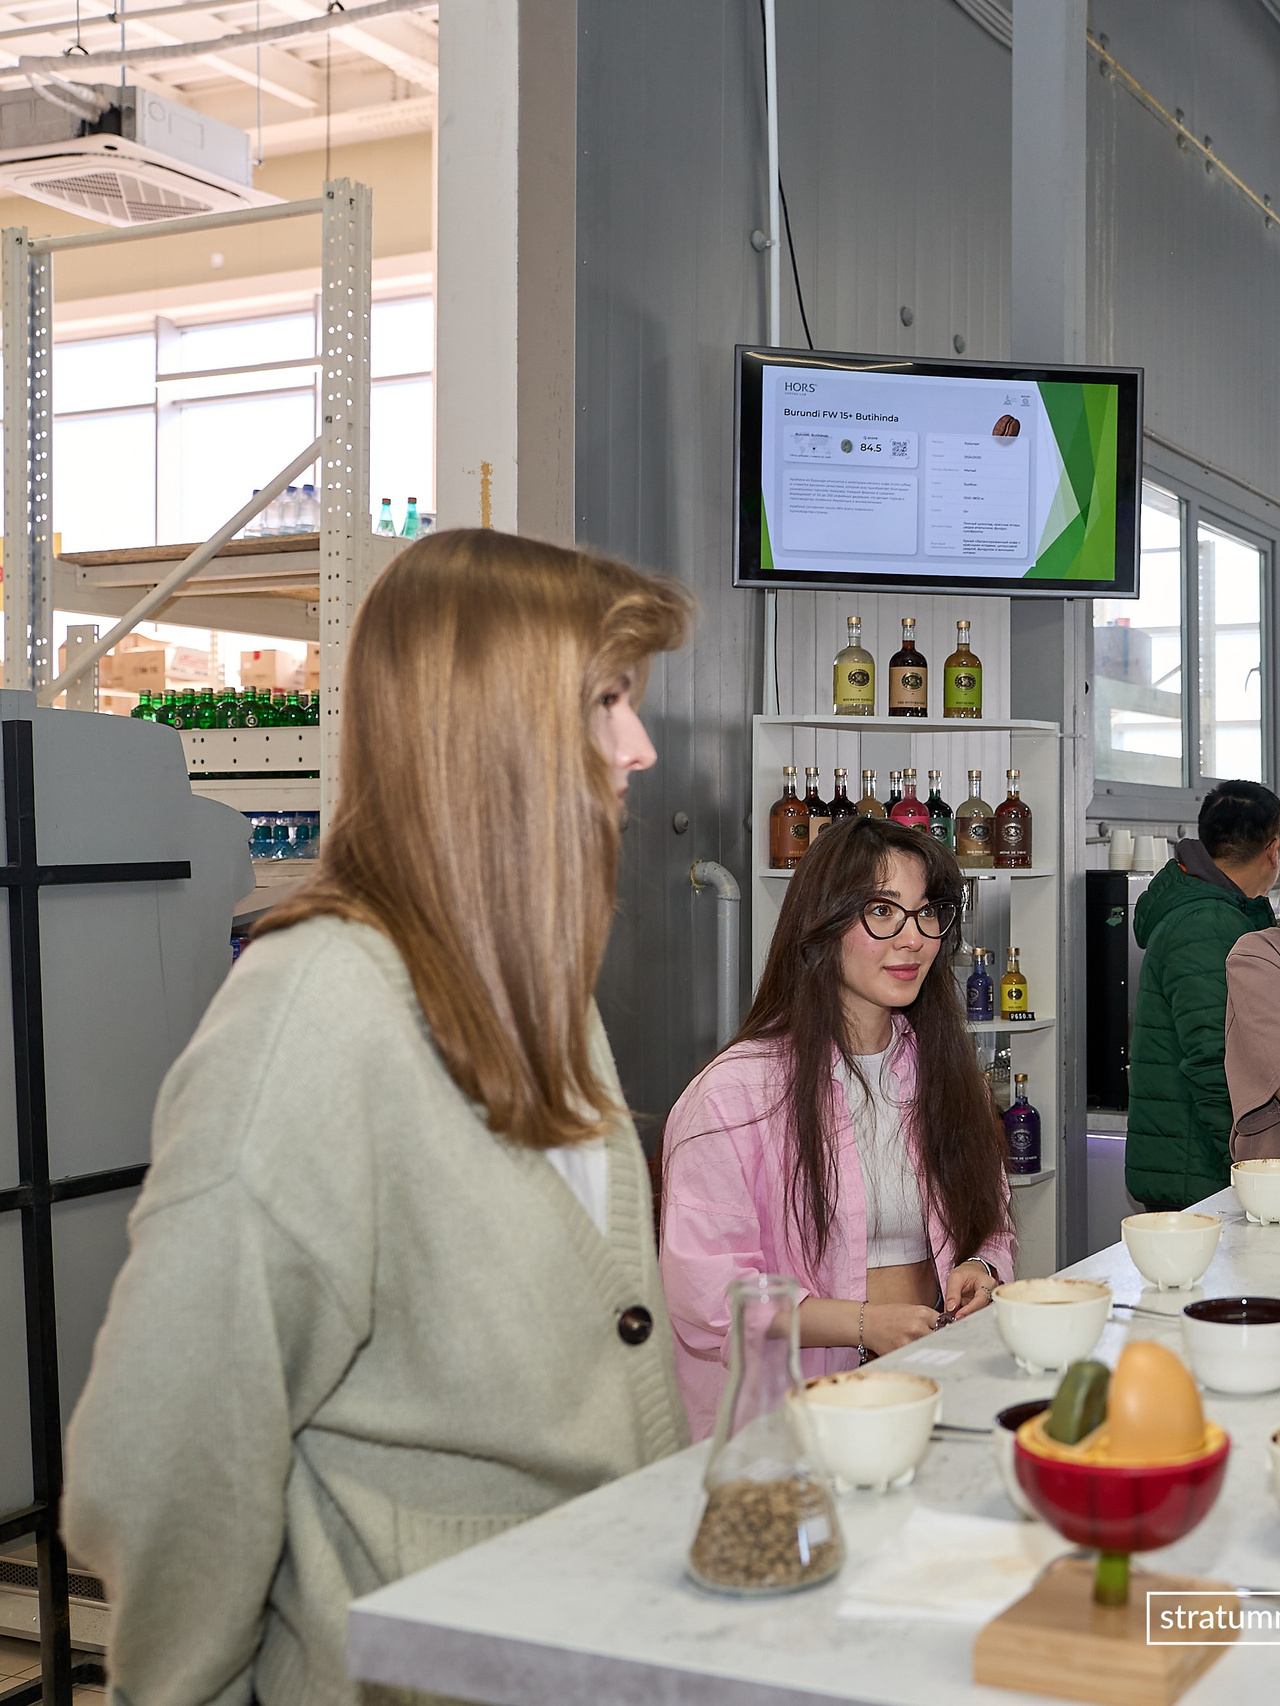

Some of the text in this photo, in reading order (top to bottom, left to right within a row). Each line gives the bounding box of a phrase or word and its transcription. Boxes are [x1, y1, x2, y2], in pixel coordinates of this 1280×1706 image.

[784, 408, 899, 422] Burundi FW 15+ Butihinda
[860, 443, 882, 453] 84.5
